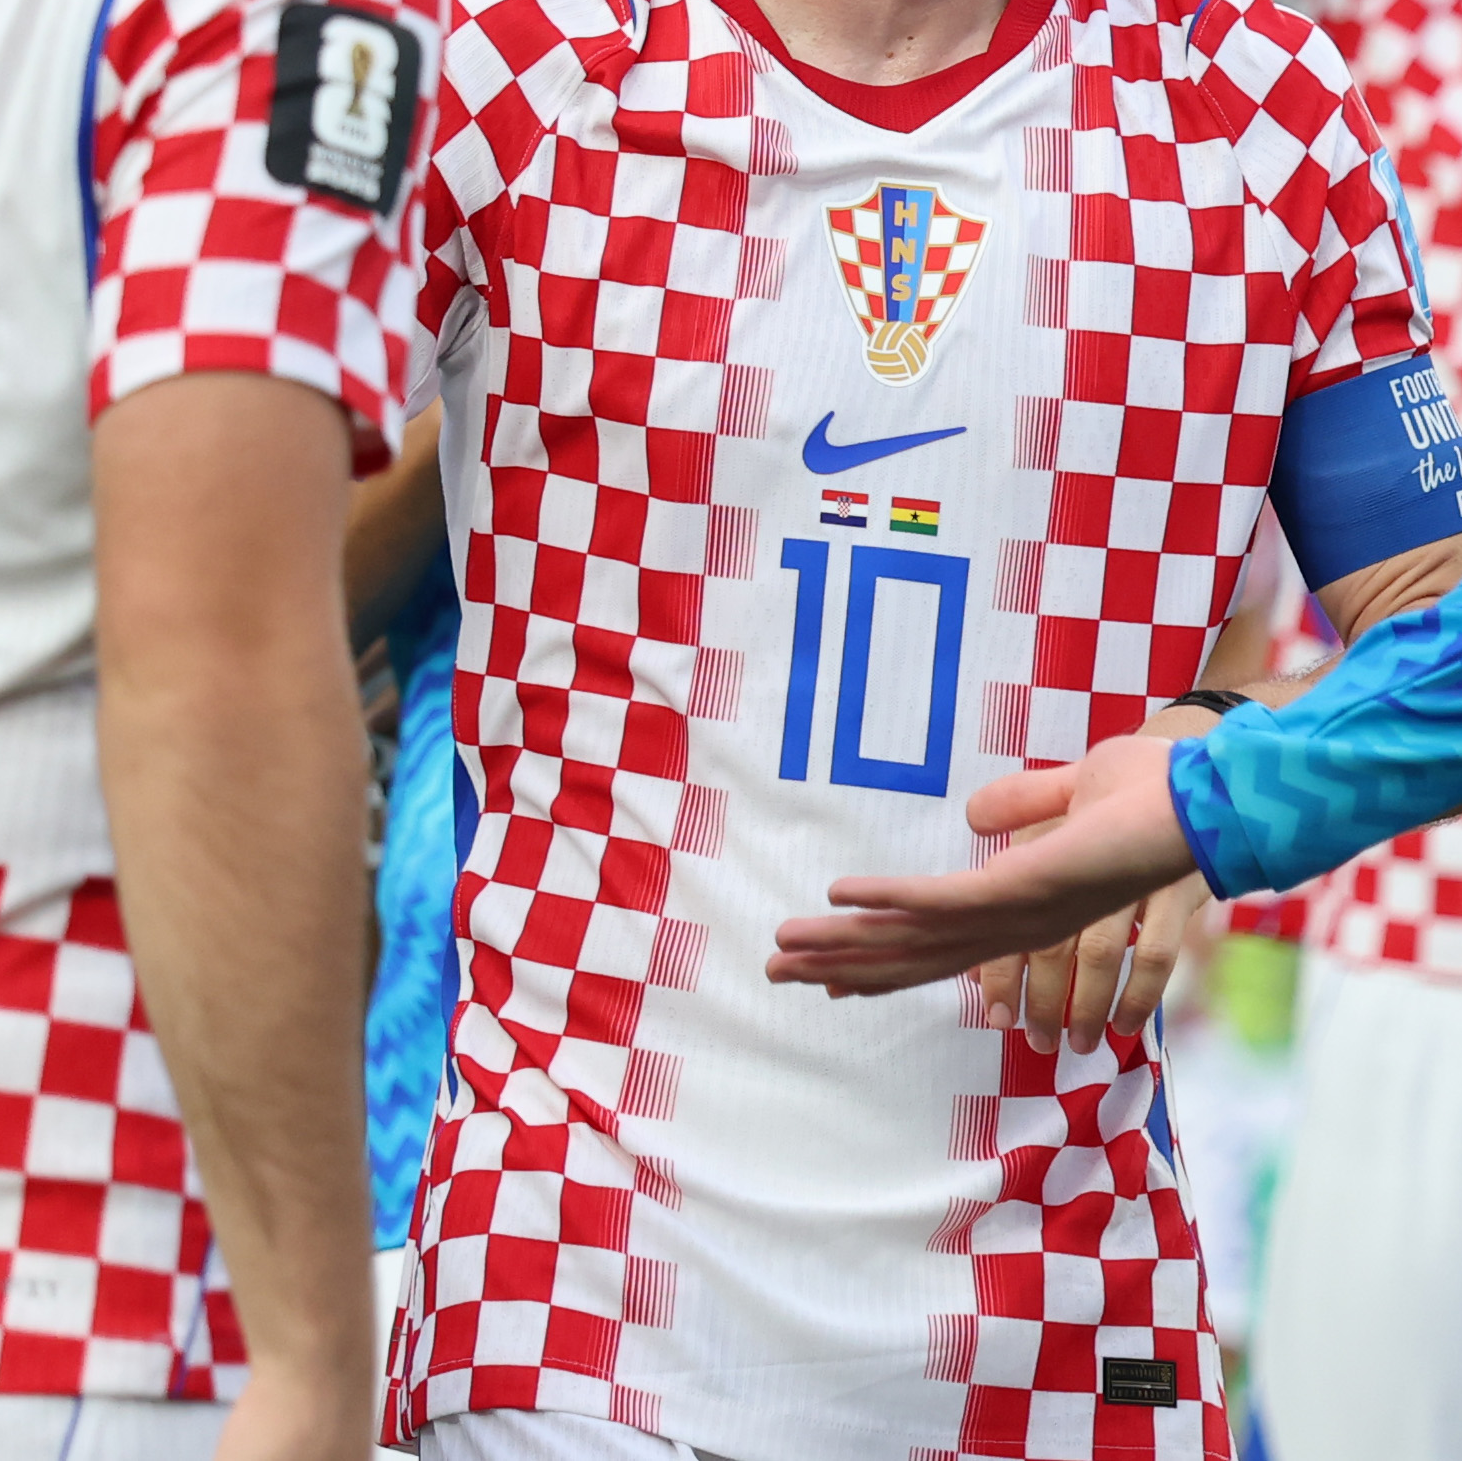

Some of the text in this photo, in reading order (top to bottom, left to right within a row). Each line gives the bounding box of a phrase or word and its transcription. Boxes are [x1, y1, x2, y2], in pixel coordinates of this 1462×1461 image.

[890, 200, 918, 302] HNS
[1411, 451, 1457, 493] the
[779, 537, 971, 798] 10
